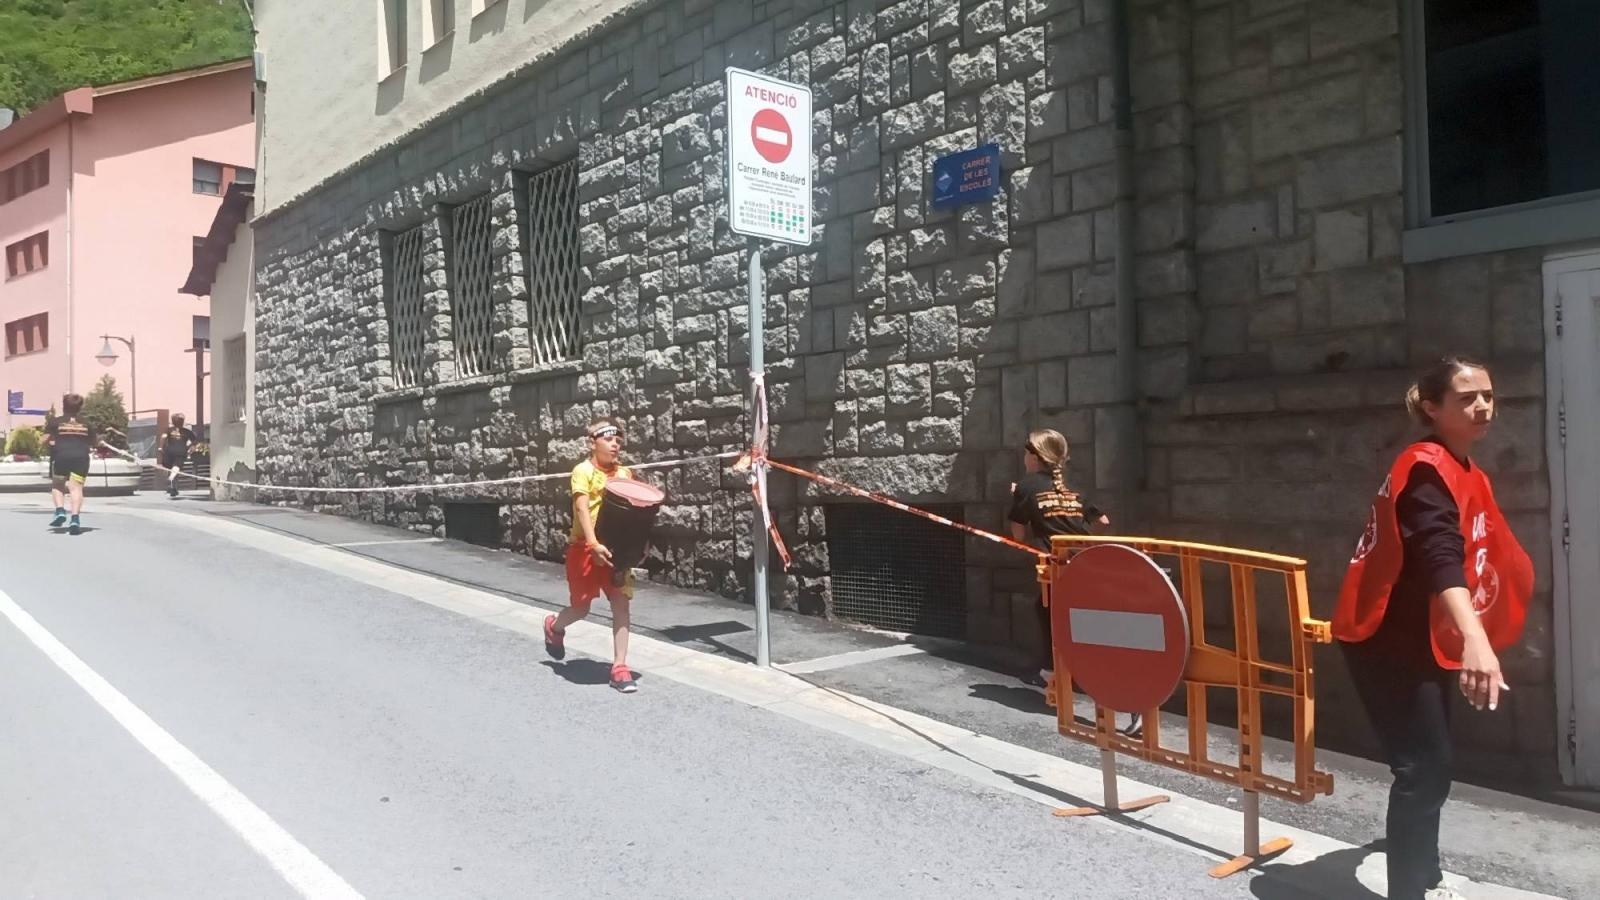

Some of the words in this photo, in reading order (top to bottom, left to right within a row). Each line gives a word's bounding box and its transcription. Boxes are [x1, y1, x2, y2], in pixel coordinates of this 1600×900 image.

[745, 85, 797, 109] ATENCIÓ
[737, 162, 759, 176] Carrer
[962, 156, 991, 170] CARRER
[974, 167, 988, 178] LES
[960, 178, 992, 192] ESCOLES
